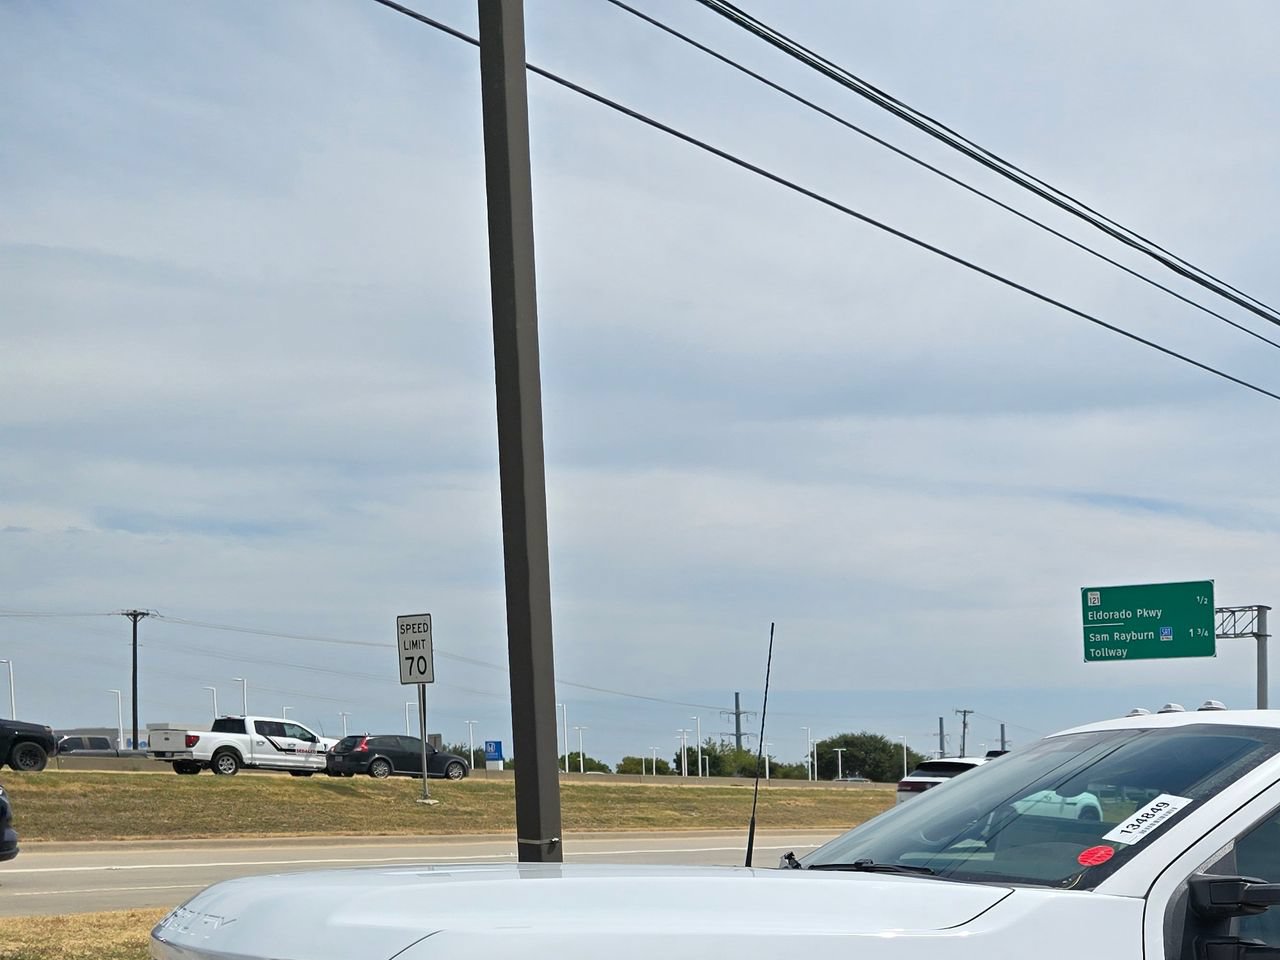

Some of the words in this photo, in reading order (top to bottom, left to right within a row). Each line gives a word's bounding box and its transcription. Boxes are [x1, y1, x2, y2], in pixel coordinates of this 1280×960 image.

[1088, 610, 1132, 620] Eldorado
[1137, 608, 1162, 620] Pkwy
[400, 623, 428, 634] SPEED
[1090, 632, 1110, 642] Sam
[1114, 630, 1154, 642] Rayburn
[404, 639, 426, 650] LIMIT
[1090, 648, 1128, 658] Tollway
[405, 656, 427, 676] 70
[1120, 801, 1170, 835] 134849
